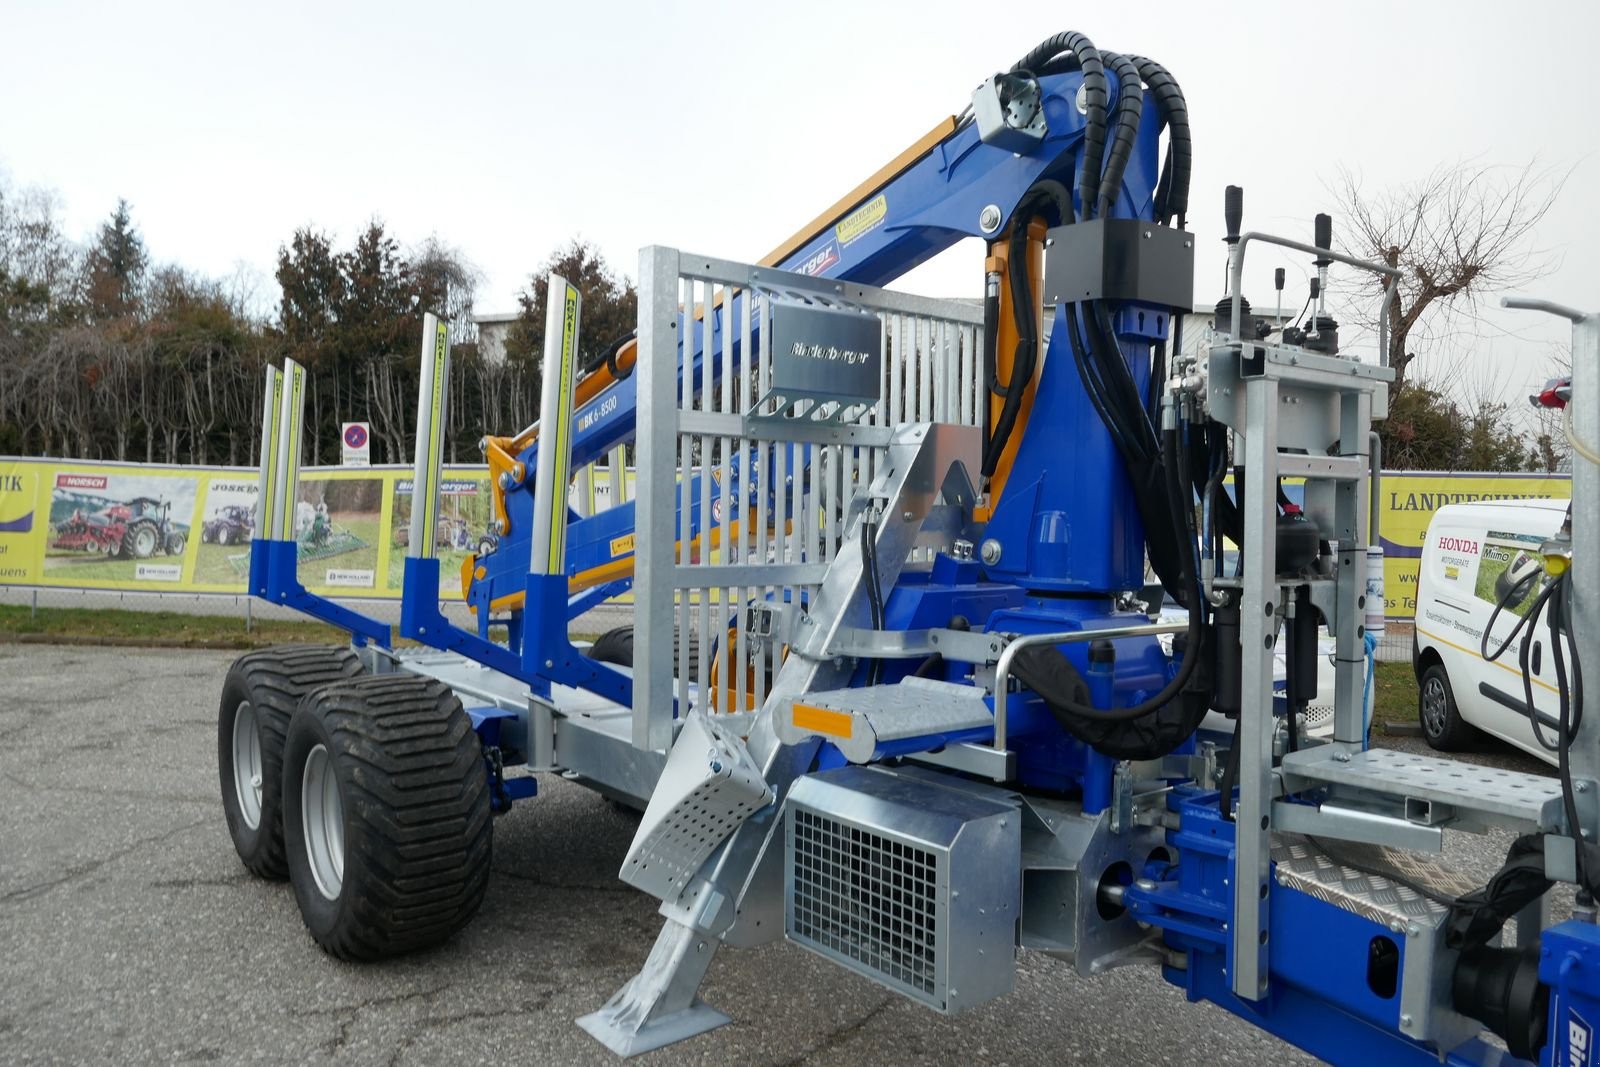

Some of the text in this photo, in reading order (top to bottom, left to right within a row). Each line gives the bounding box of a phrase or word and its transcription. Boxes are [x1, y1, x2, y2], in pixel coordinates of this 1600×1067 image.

[790, 342, 869, 364] Binderberger
[584, 411, 594, 429] BK
[0, 475, 23, 492] IK
[67, 477, 105, 487] HORSCH
[1438, 537, 1479, 554] HONDA
[1483, 547, 1510, 561] Miimo
